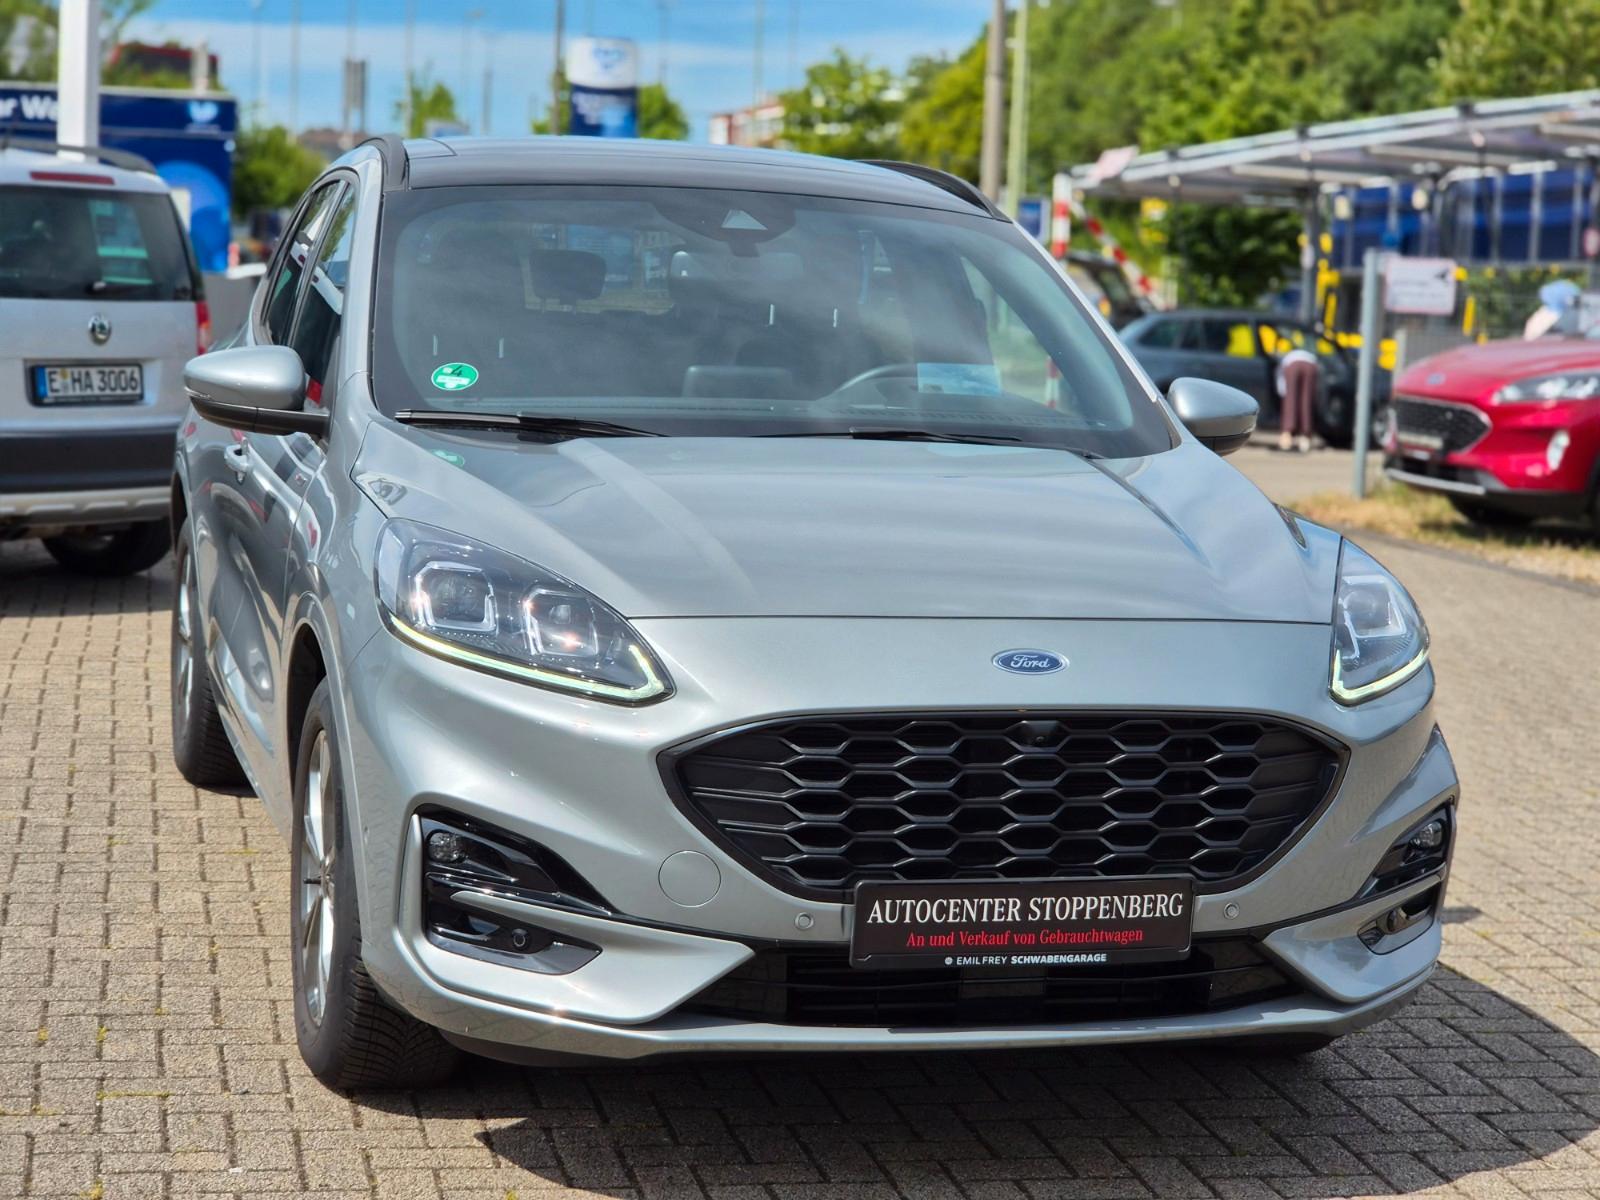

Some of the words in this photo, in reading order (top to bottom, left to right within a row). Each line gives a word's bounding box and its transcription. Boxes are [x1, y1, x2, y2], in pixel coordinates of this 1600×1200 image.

[450, 364, 463, 377] 4
[71, 370, 94, 392] HA
[97, 369, 139, 392] 3006
[1010, 654, 1050, 668] Ford
[866, 897, 1021, 924] AUTOCENTER
[1028, 892, 1184, 922] STOPPENBERG
[906, 932, 925, 947] An
[929, 931, 955, 947] und
[959, 930, 1011, 945] Verkauf
[1013, 935, 1035, 945] von
[1039, 928, 1144, 946] Gebrauchtwagen
[1010, 953, 1108, 965] SCHWABENGARAGE
